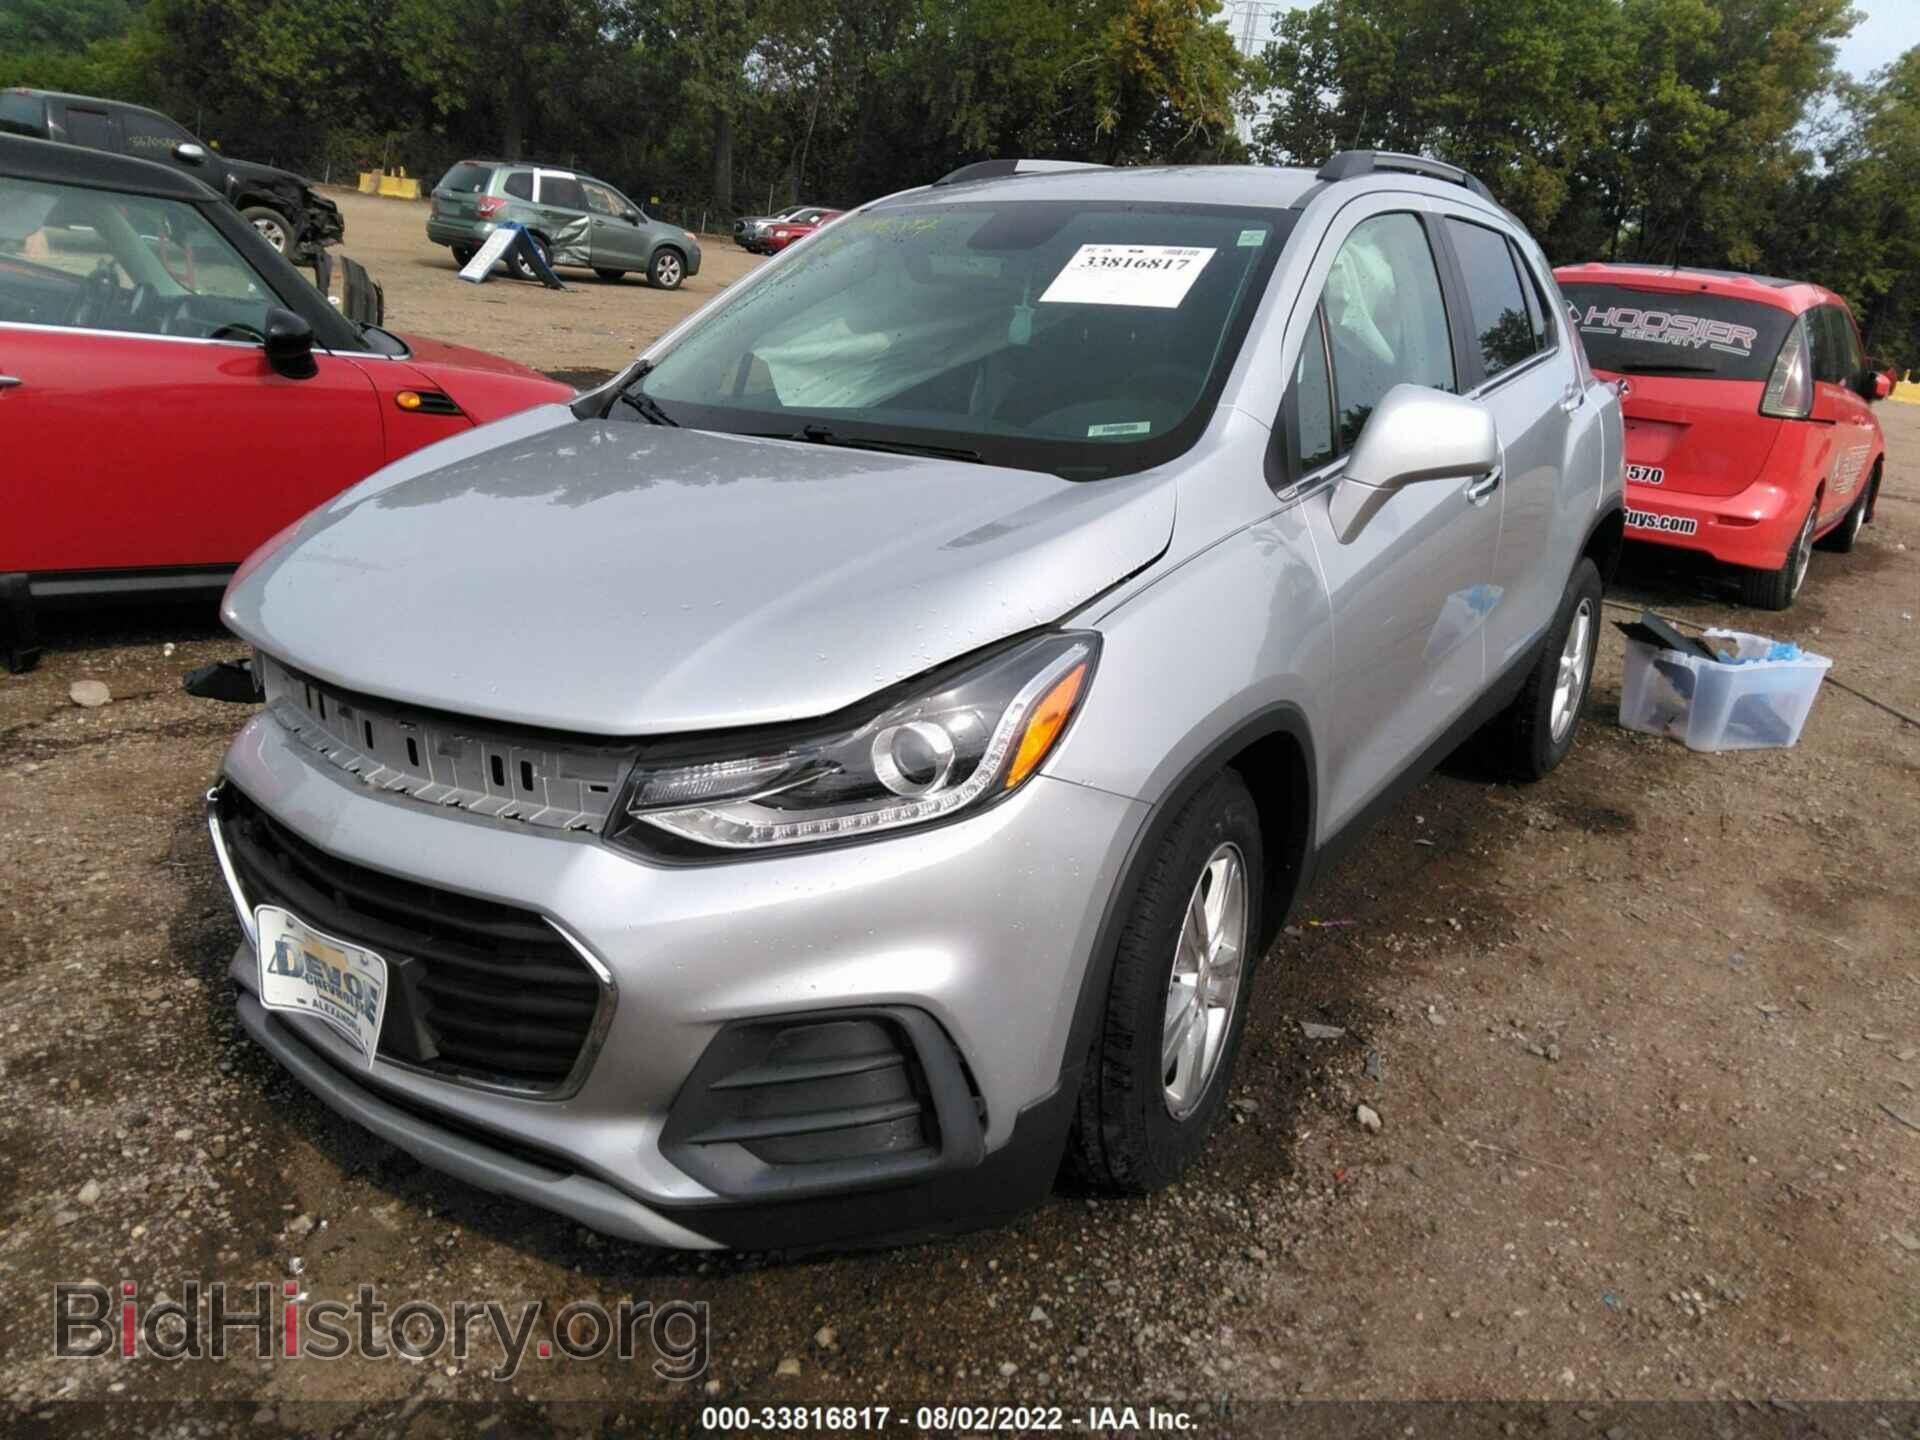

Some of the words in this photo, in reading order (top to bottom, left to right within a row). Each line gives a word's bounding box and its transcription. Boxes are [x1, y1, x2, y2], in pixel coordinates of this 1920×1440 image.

[1080, 256, 1191, 270] 33816817
[1584, 306, 1757, 349] HOOSIER
[1620, 328, 1706, 349] SECURITY
